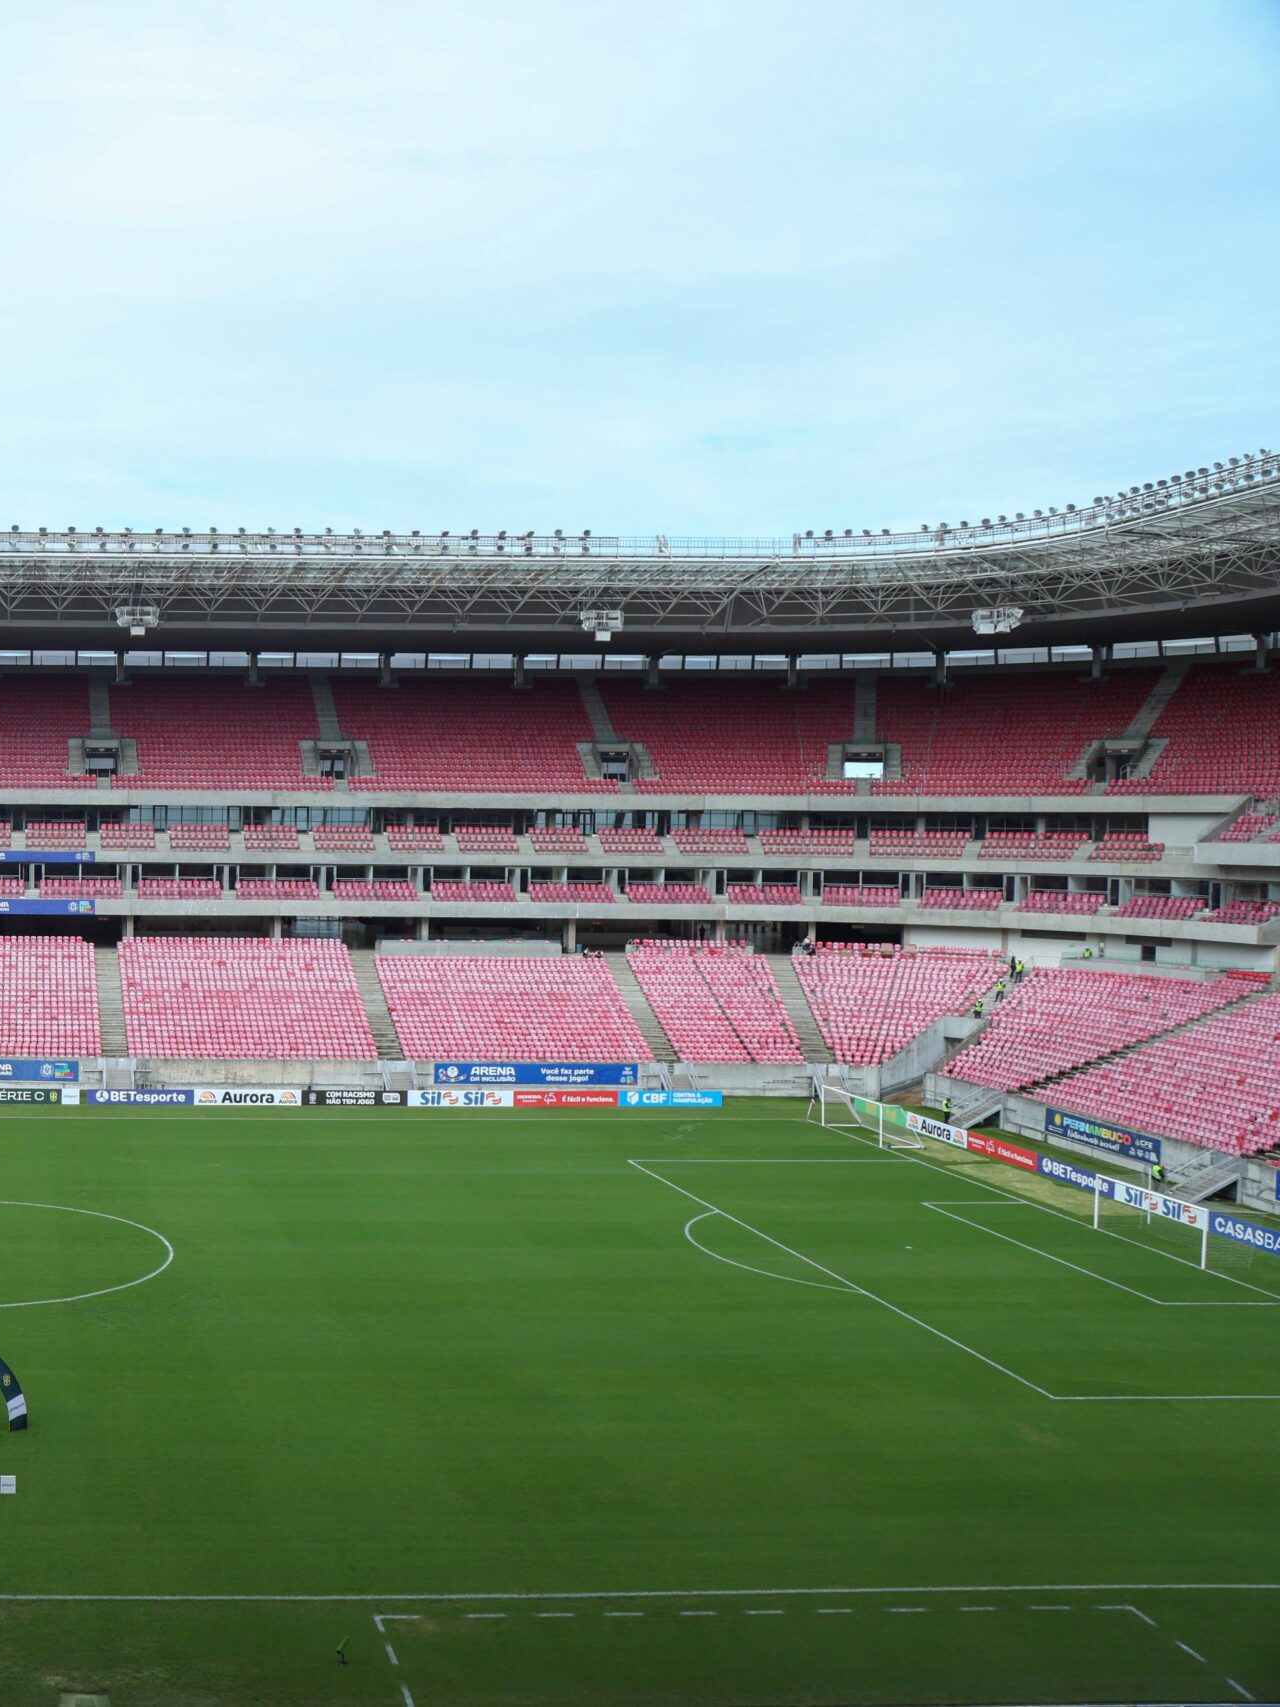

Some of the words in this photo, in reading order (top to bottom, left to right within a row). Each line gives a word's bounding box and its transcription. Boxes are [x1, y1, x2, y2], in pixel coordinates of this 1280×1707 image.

[470, 1067, 515, 1075] ARENA
[34, 1091, 45, 1101] C
[110, 1091, 185, 1104] BETesporte
[221, 1092, 274, 1104] Aurora
[420, 1092, 441, 1105] Sil
[463, 1092, 484, 1105] Sil
[642, 1094, 668, 1104] CBF
[921, 1120, 951, 1140] Aurora
[1063, 1116, 1132, 1146] PERNAMBUCO
[1052, 1161, 1109, 1192] BETespote
[1125, 1186, 1144, 1207] Sil
[1162, 1199, 1182, 1220] Sil
